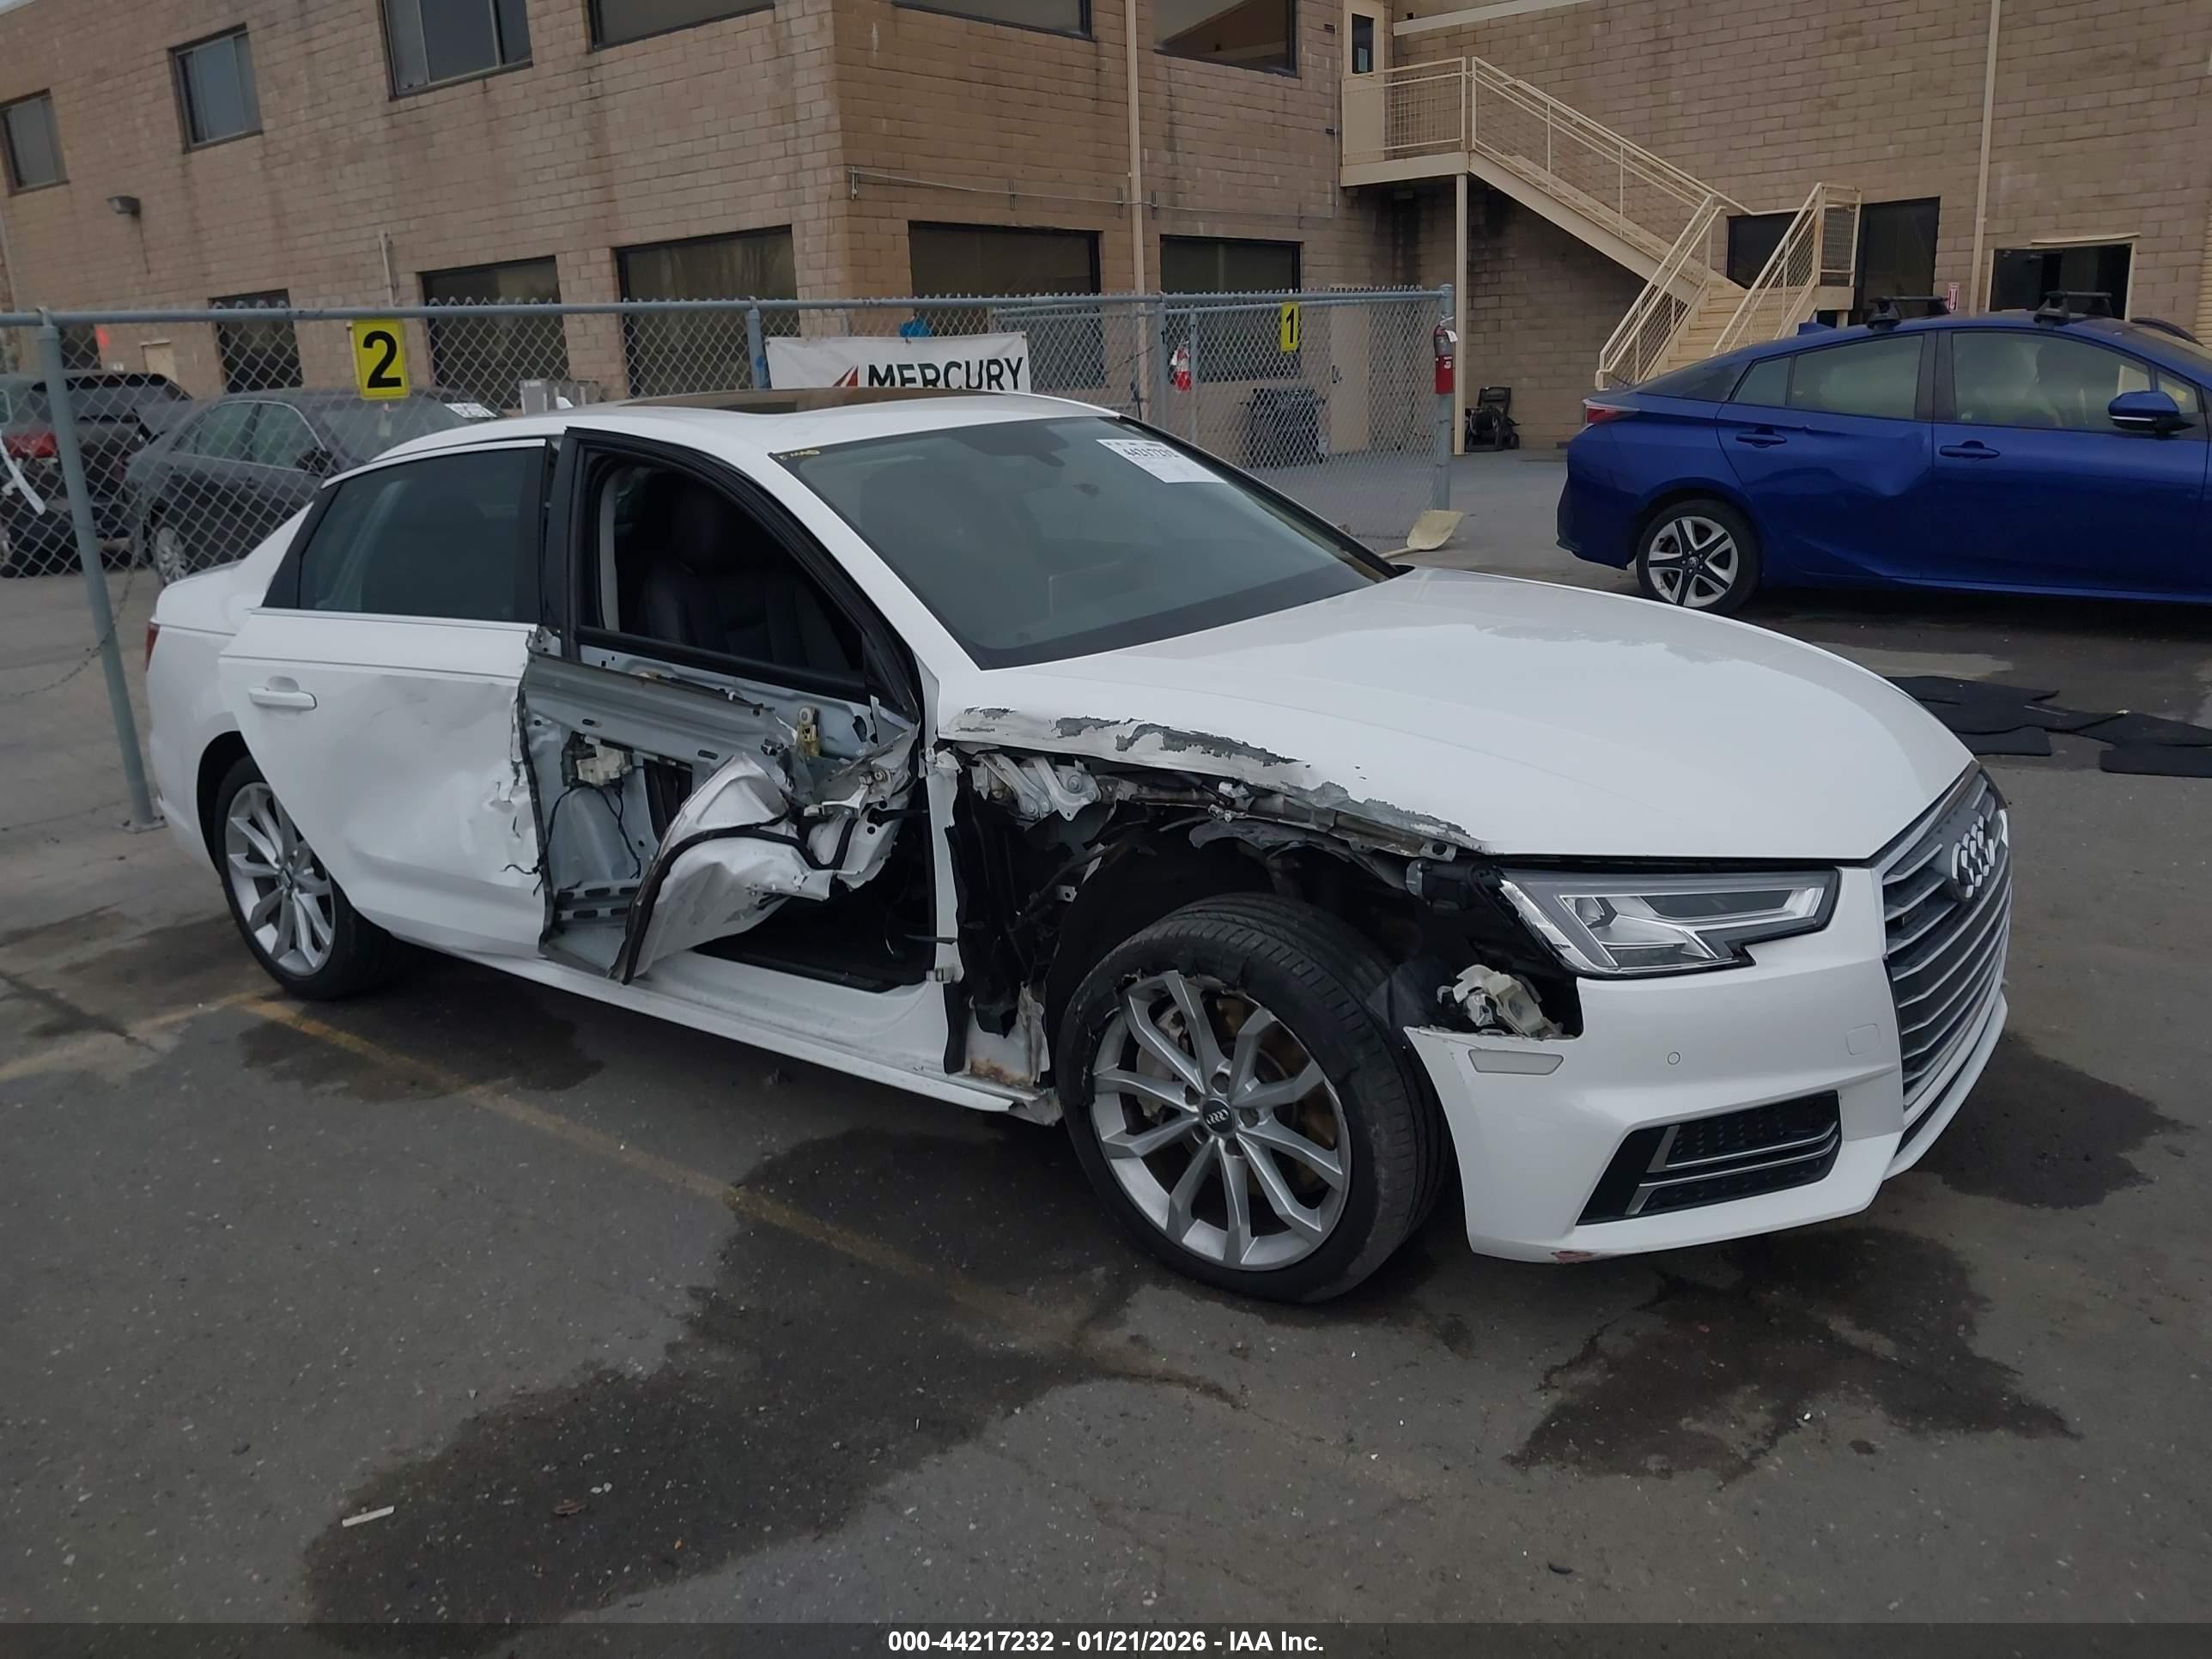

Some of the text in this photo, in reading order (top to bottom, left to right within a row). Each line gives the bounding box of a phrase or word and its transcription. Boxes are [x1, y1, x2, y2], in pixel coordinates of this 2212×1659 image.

[1286, 308, 1295, 344] 1
[363, 331, 401, 388] 2
[868, 356, 1023, 390] MERCURY
